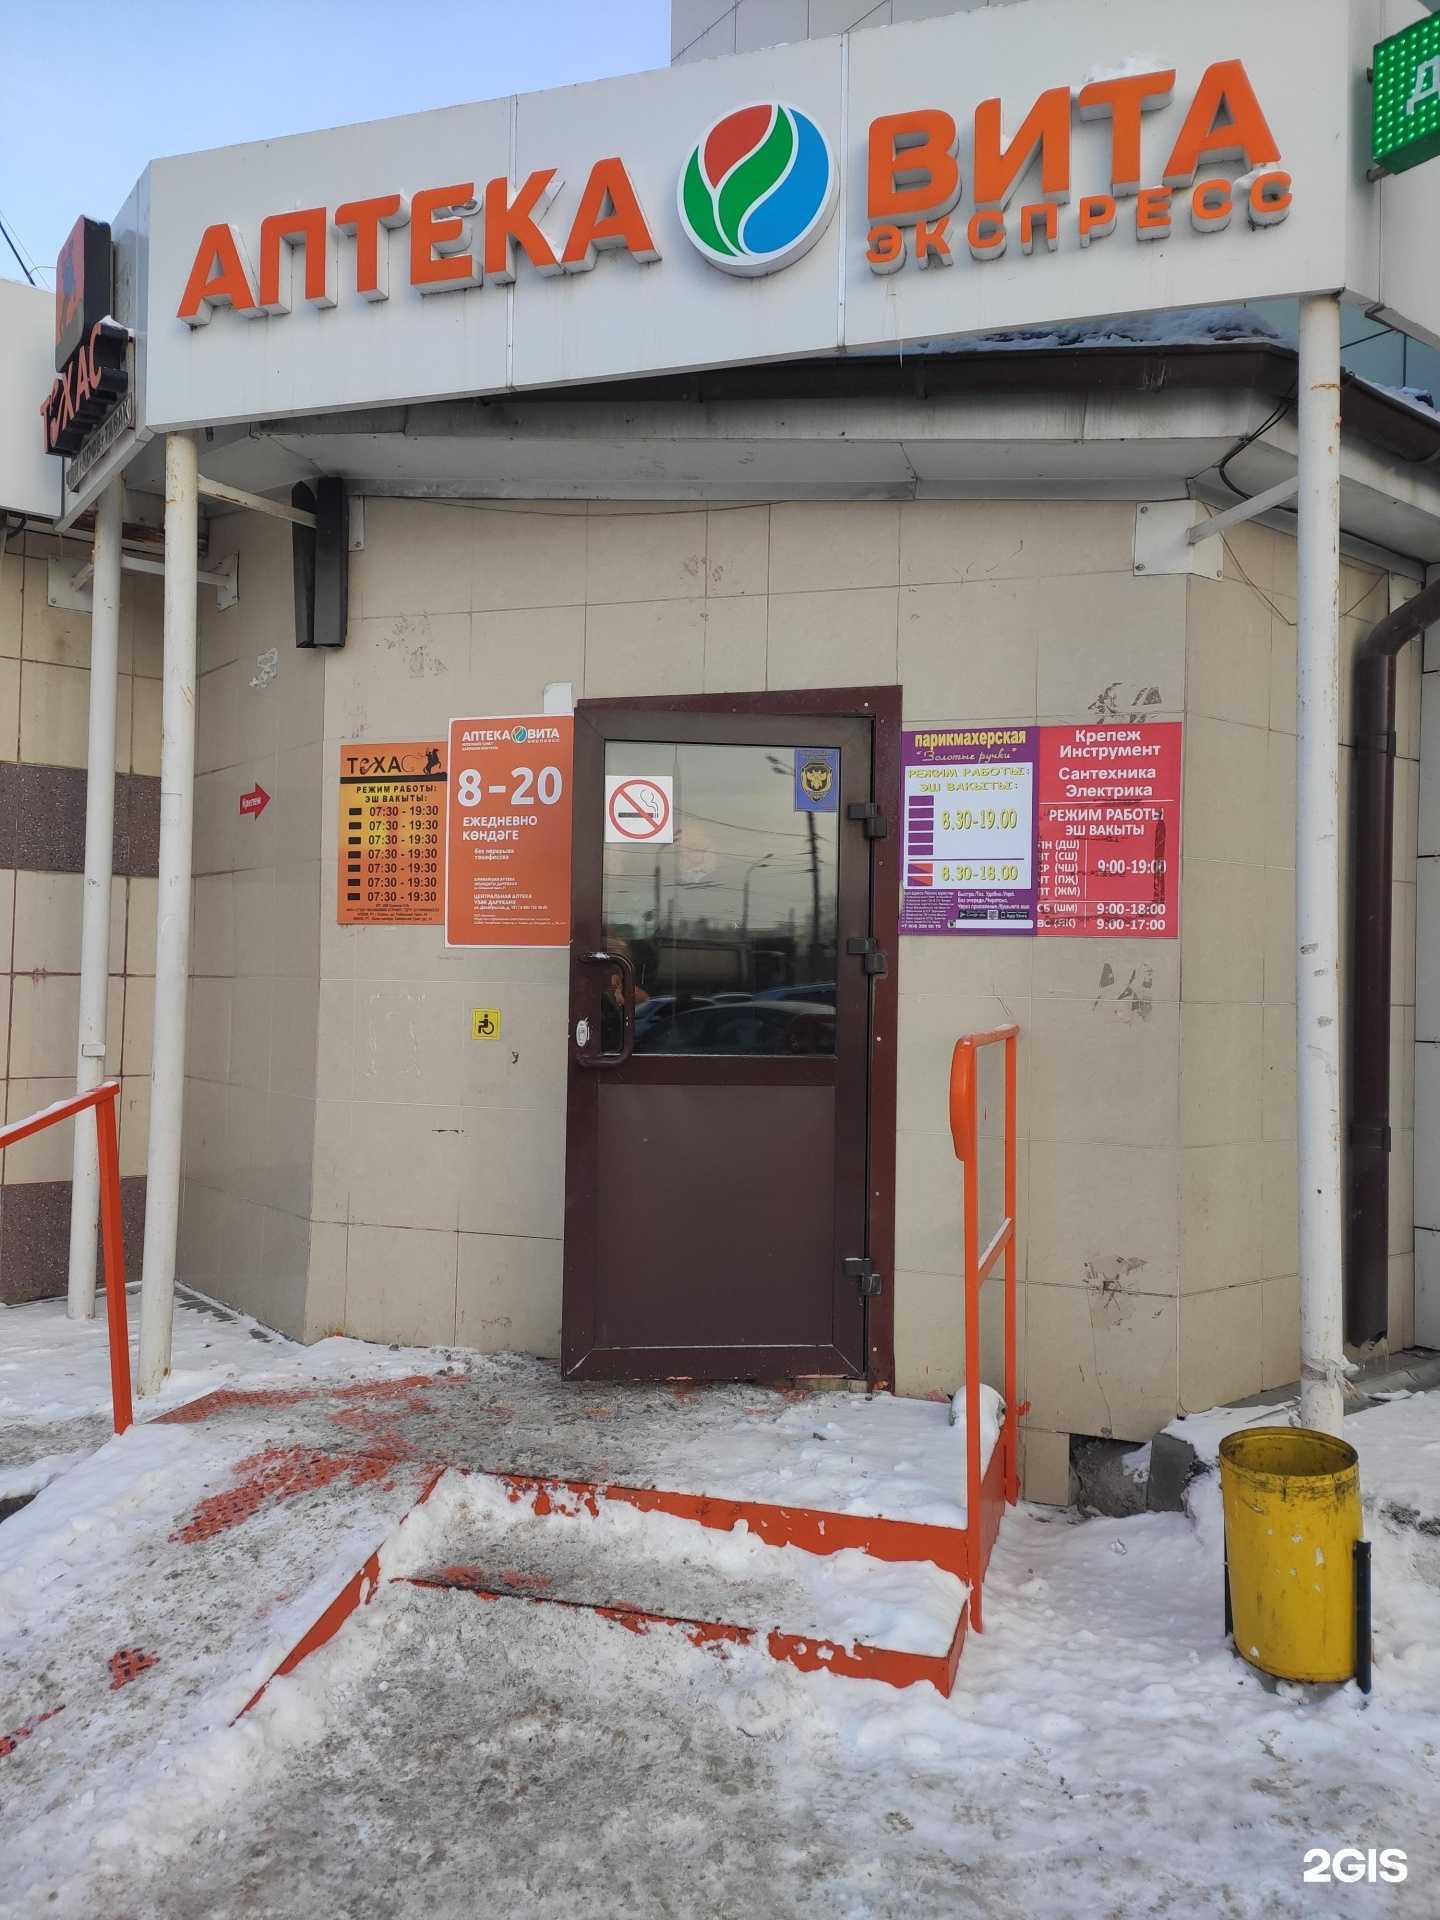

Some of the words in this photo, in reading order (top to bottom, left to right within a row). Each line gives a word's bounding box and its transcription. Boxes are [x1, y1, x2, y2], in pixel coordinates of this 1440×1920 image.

[177, 157, 659, 325] АПТЕКА
[868, 58, 1281, 225] ВИТА
[867, 170, 1293, 276] ЭКСПРЕСС
[462, 730, 511, 741] АПТЕКА
[528, 728, 560, 739] ВИТА
[915, 730, 1026, 750] парикмахерская
[1075, 730, 1141, 745] Крепеж
[1060, 745, 1161, 760] Инструмент
[1059, 767, 1156, 780] Сантехника
[356, 785, 390, 793] РЕЖИМ
[393, 784, 437, 793] РАБОТЫ:
[1066, 784, 1152, 799] Электрика
[365, 795, 379, 803] ЭШ
[382, 794, 427, 803] ВАКЫТЫ:
[369, 805, 399, 816] 07:30
[409, 805, 439, 816] 19:30
[1049, 809, 1102, 821] РЕЖИМ
[369, 820, 398, 831] 07:30
[409, 820, 438, 831] 19:30
[463, 816, 538, 828] ЕЖЕДНЕВНО
[942, 808, 1018, 831] 8.30-19.00
[463, 830, 519, 842] КӨНДӘГЕ
[1066, 825, 1085, 836] ЭШ
[1089, 824, 1145, 836] ВАКЫТЫ
[368, 835, 398, 845] 07:30
[408, 835, 438, 845] 19:30
[1055, 840, 1080, 850] (ДШ)
[368, 849, 397, 859] 07:30
[408, 849, 437, 859] 19:30
[1055, 851, 1078, 862] (СШ)
[368, 863, 397, 874] 07:30
[408, 863, 437, 874] 19:30
[1055, 863, 1078, 874] (ЧШ)
[1098, 860, 1167, 875] 9:00-19:00
[367, 877, 397, 888] 07:30
[408, 877, 437, 888] 19:30
[367, 892, 397, 902] 07:30
[407, 892, 437, 902] 19:30
[1054, 886, 1080, 897] (ЖМ)
[1037, 903, 1050, 912] СБ
[1054, 903, 1078, 913] (ШМ)
[1097, 903, 1166, 915] 9:00-18:00
[1037, 919, 1051, 928] ВС
[1097, 918, 1166, 931] 9:00-17:00
